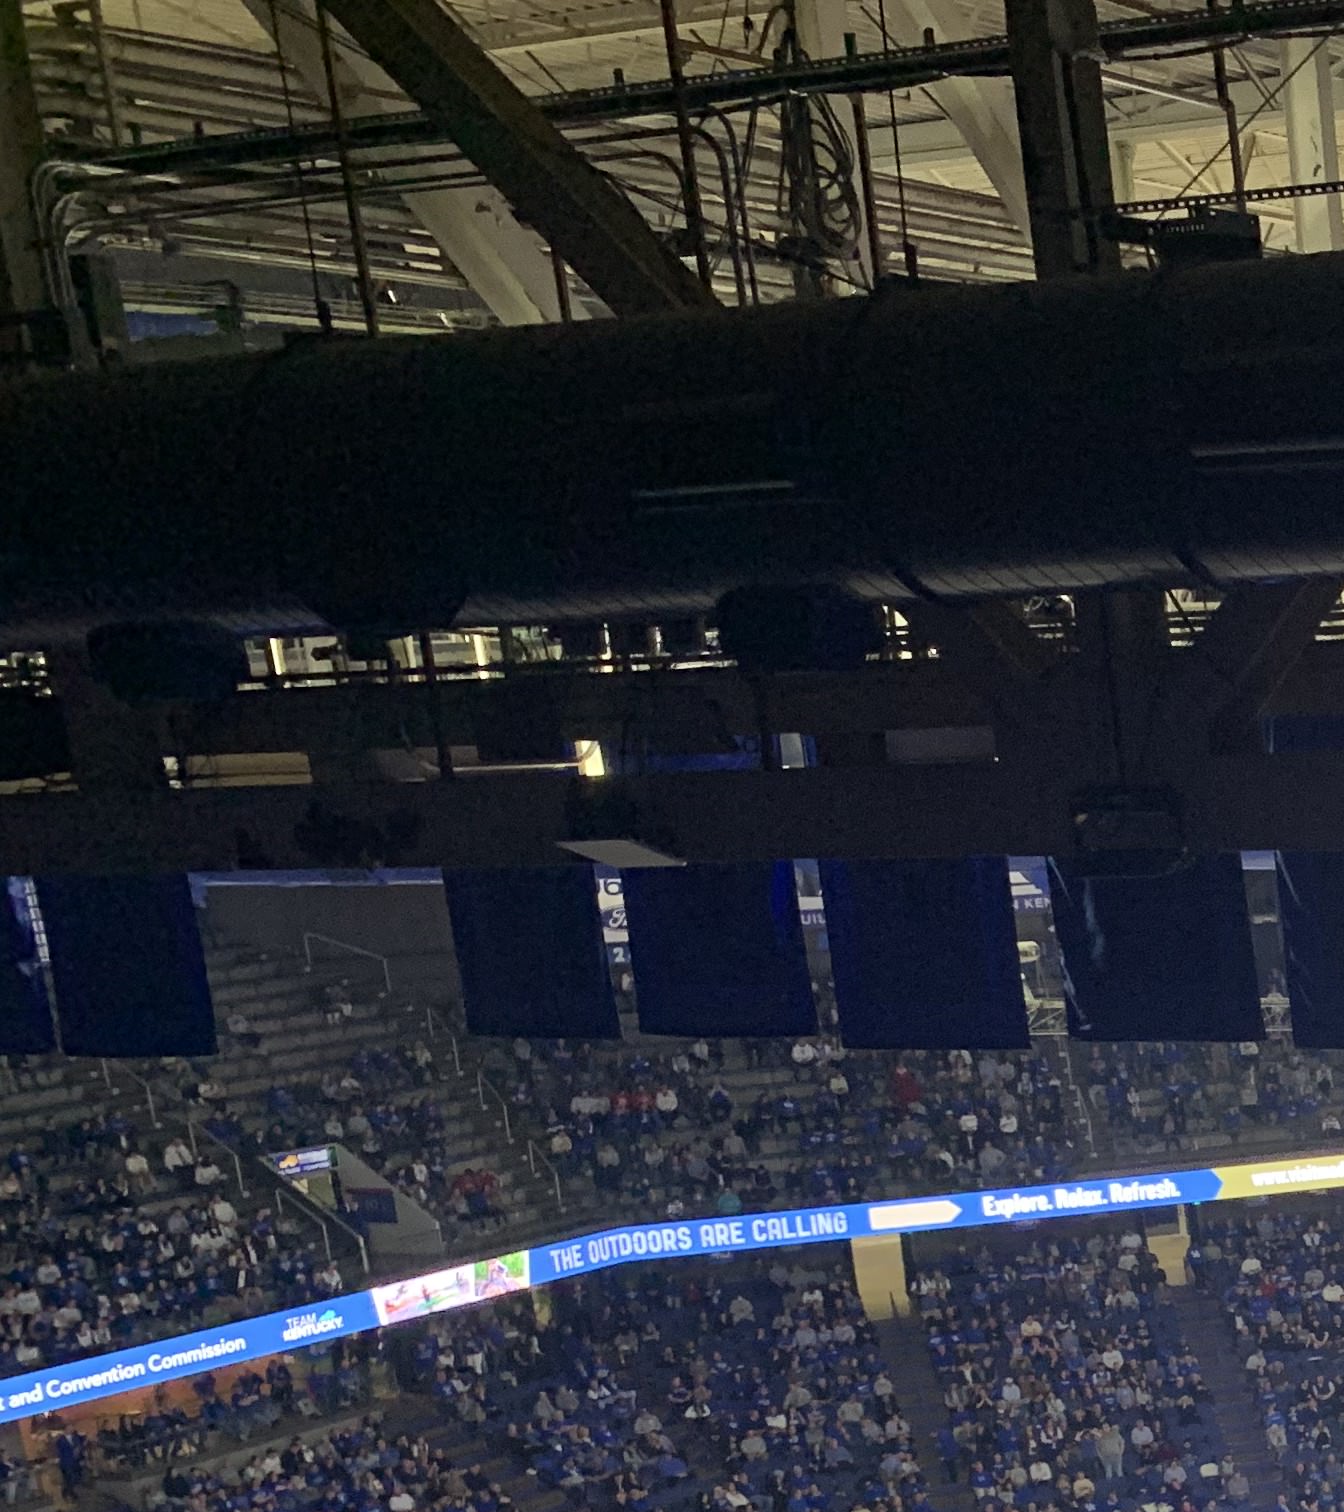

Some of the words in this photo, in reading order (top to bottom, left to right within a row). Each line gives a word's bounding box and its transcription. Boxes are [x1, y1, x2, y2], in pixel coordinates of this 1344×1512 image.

[550, 1245, 584, 1273] THE
[588, 1226, 692, 1265] OUTDOORS
[701, 1221, 745, 1248] ARE
[752, 1211, 848, 1242] CALLING
[285, 1312, 317, 1328] TEAM
[9, 1387, 43, 1408] and
[46, 1362, 146, 1399] Convention
[147, 1336, 247, 1373] Commission
